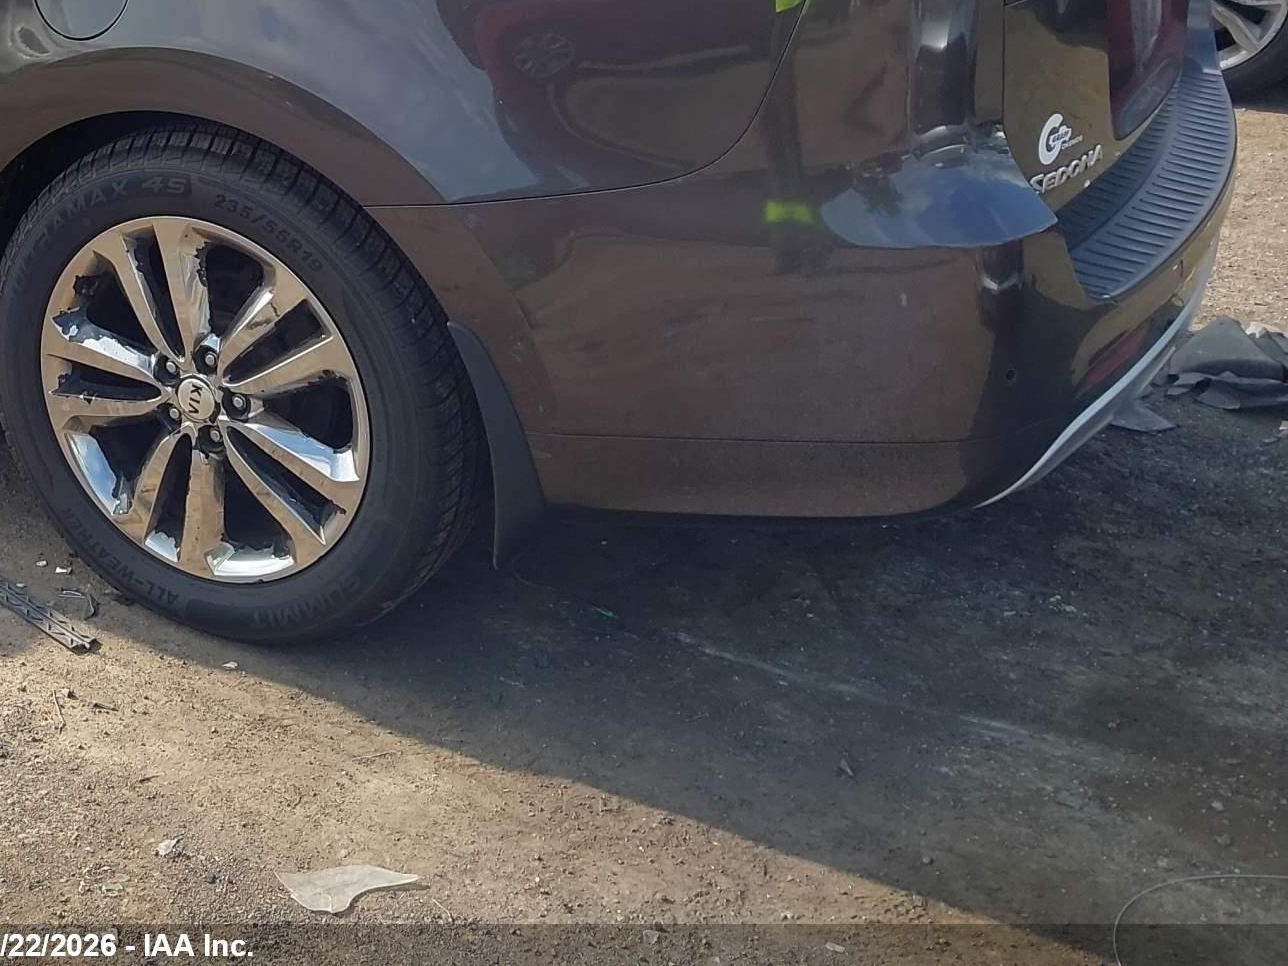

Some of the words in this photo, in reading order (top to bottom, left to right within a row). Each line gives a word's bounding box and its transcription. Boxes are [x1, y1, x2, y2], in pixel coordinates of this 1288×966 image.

[141, 176, 187, 195] 4S
[1029, 144, 1103, 194] SEDONA
[213, 193, 323, 272] 235/55R19
[187, 381, 203, 414] KIA
[62, 506, 179, 603] ALL-WEATHER
